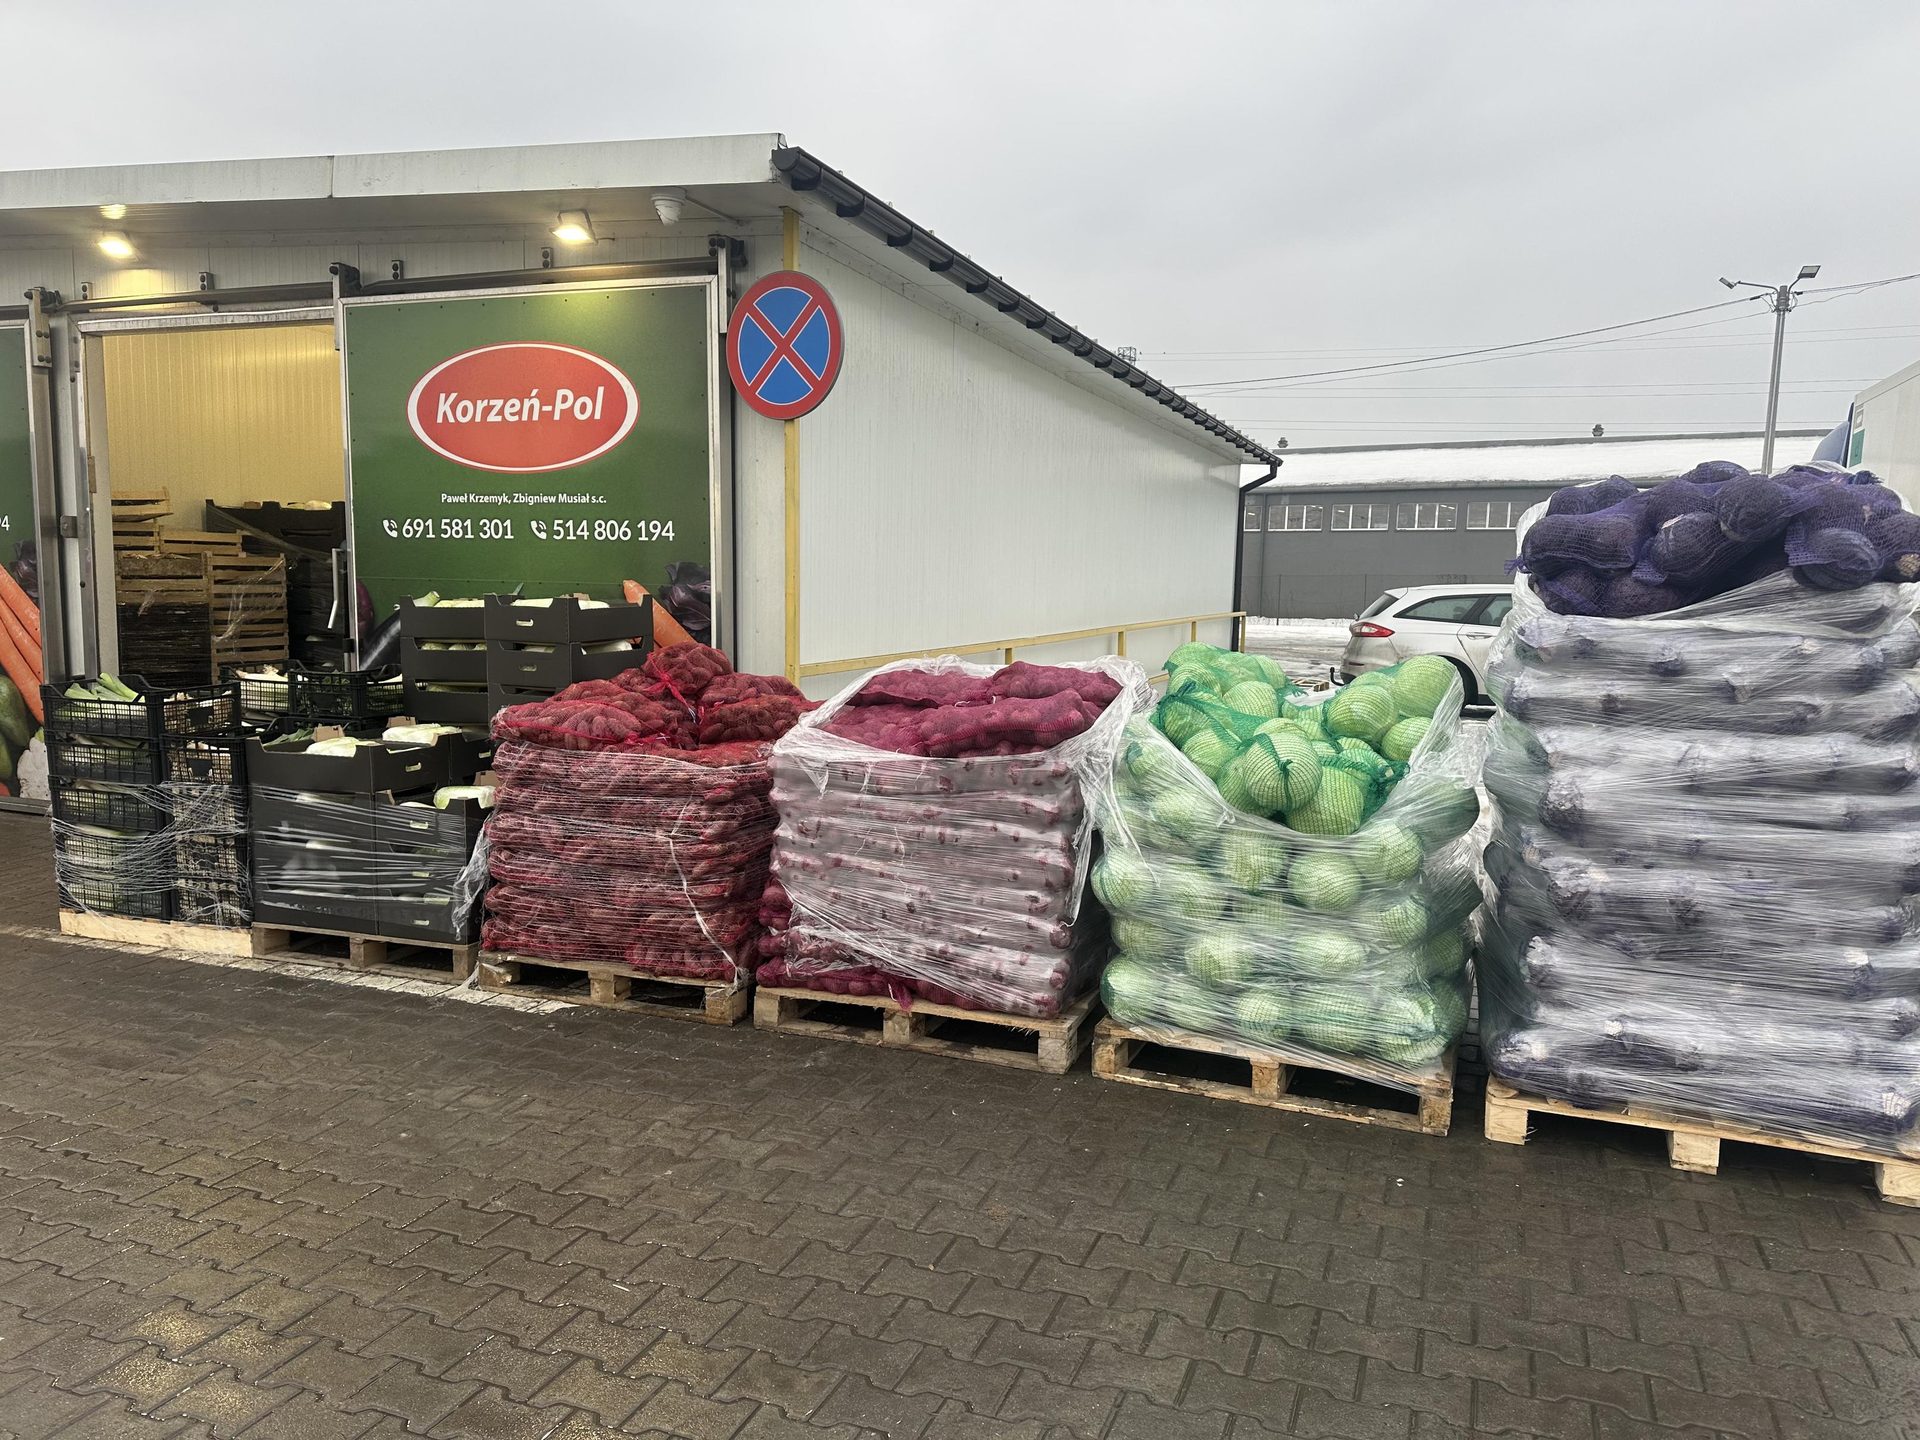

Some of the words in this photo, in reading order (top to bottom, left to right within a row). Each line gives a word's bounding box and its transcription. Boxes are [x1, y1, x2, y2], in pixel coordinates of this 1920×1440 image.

[436, 386, 605, 424] Korzeń-Pol
[441, 493, 468, 503] Paweł
[469, 493, 511, 506] Krzemyk,
[513, 493, 556, 506] Zbigniew
[558, 493, 589, 503] Musiał
[591, 495, 607, 504] s.c.
[0, 515, 10, 531] 4
[402, 518, 436, 539] 691
[440, 519, 475, 539] 581
[479, 519, 514, 539] 301
[553, 519, 590, 540] 514
[594, 520, 632, 541] 806
[637, 520, 675, 541] 194
